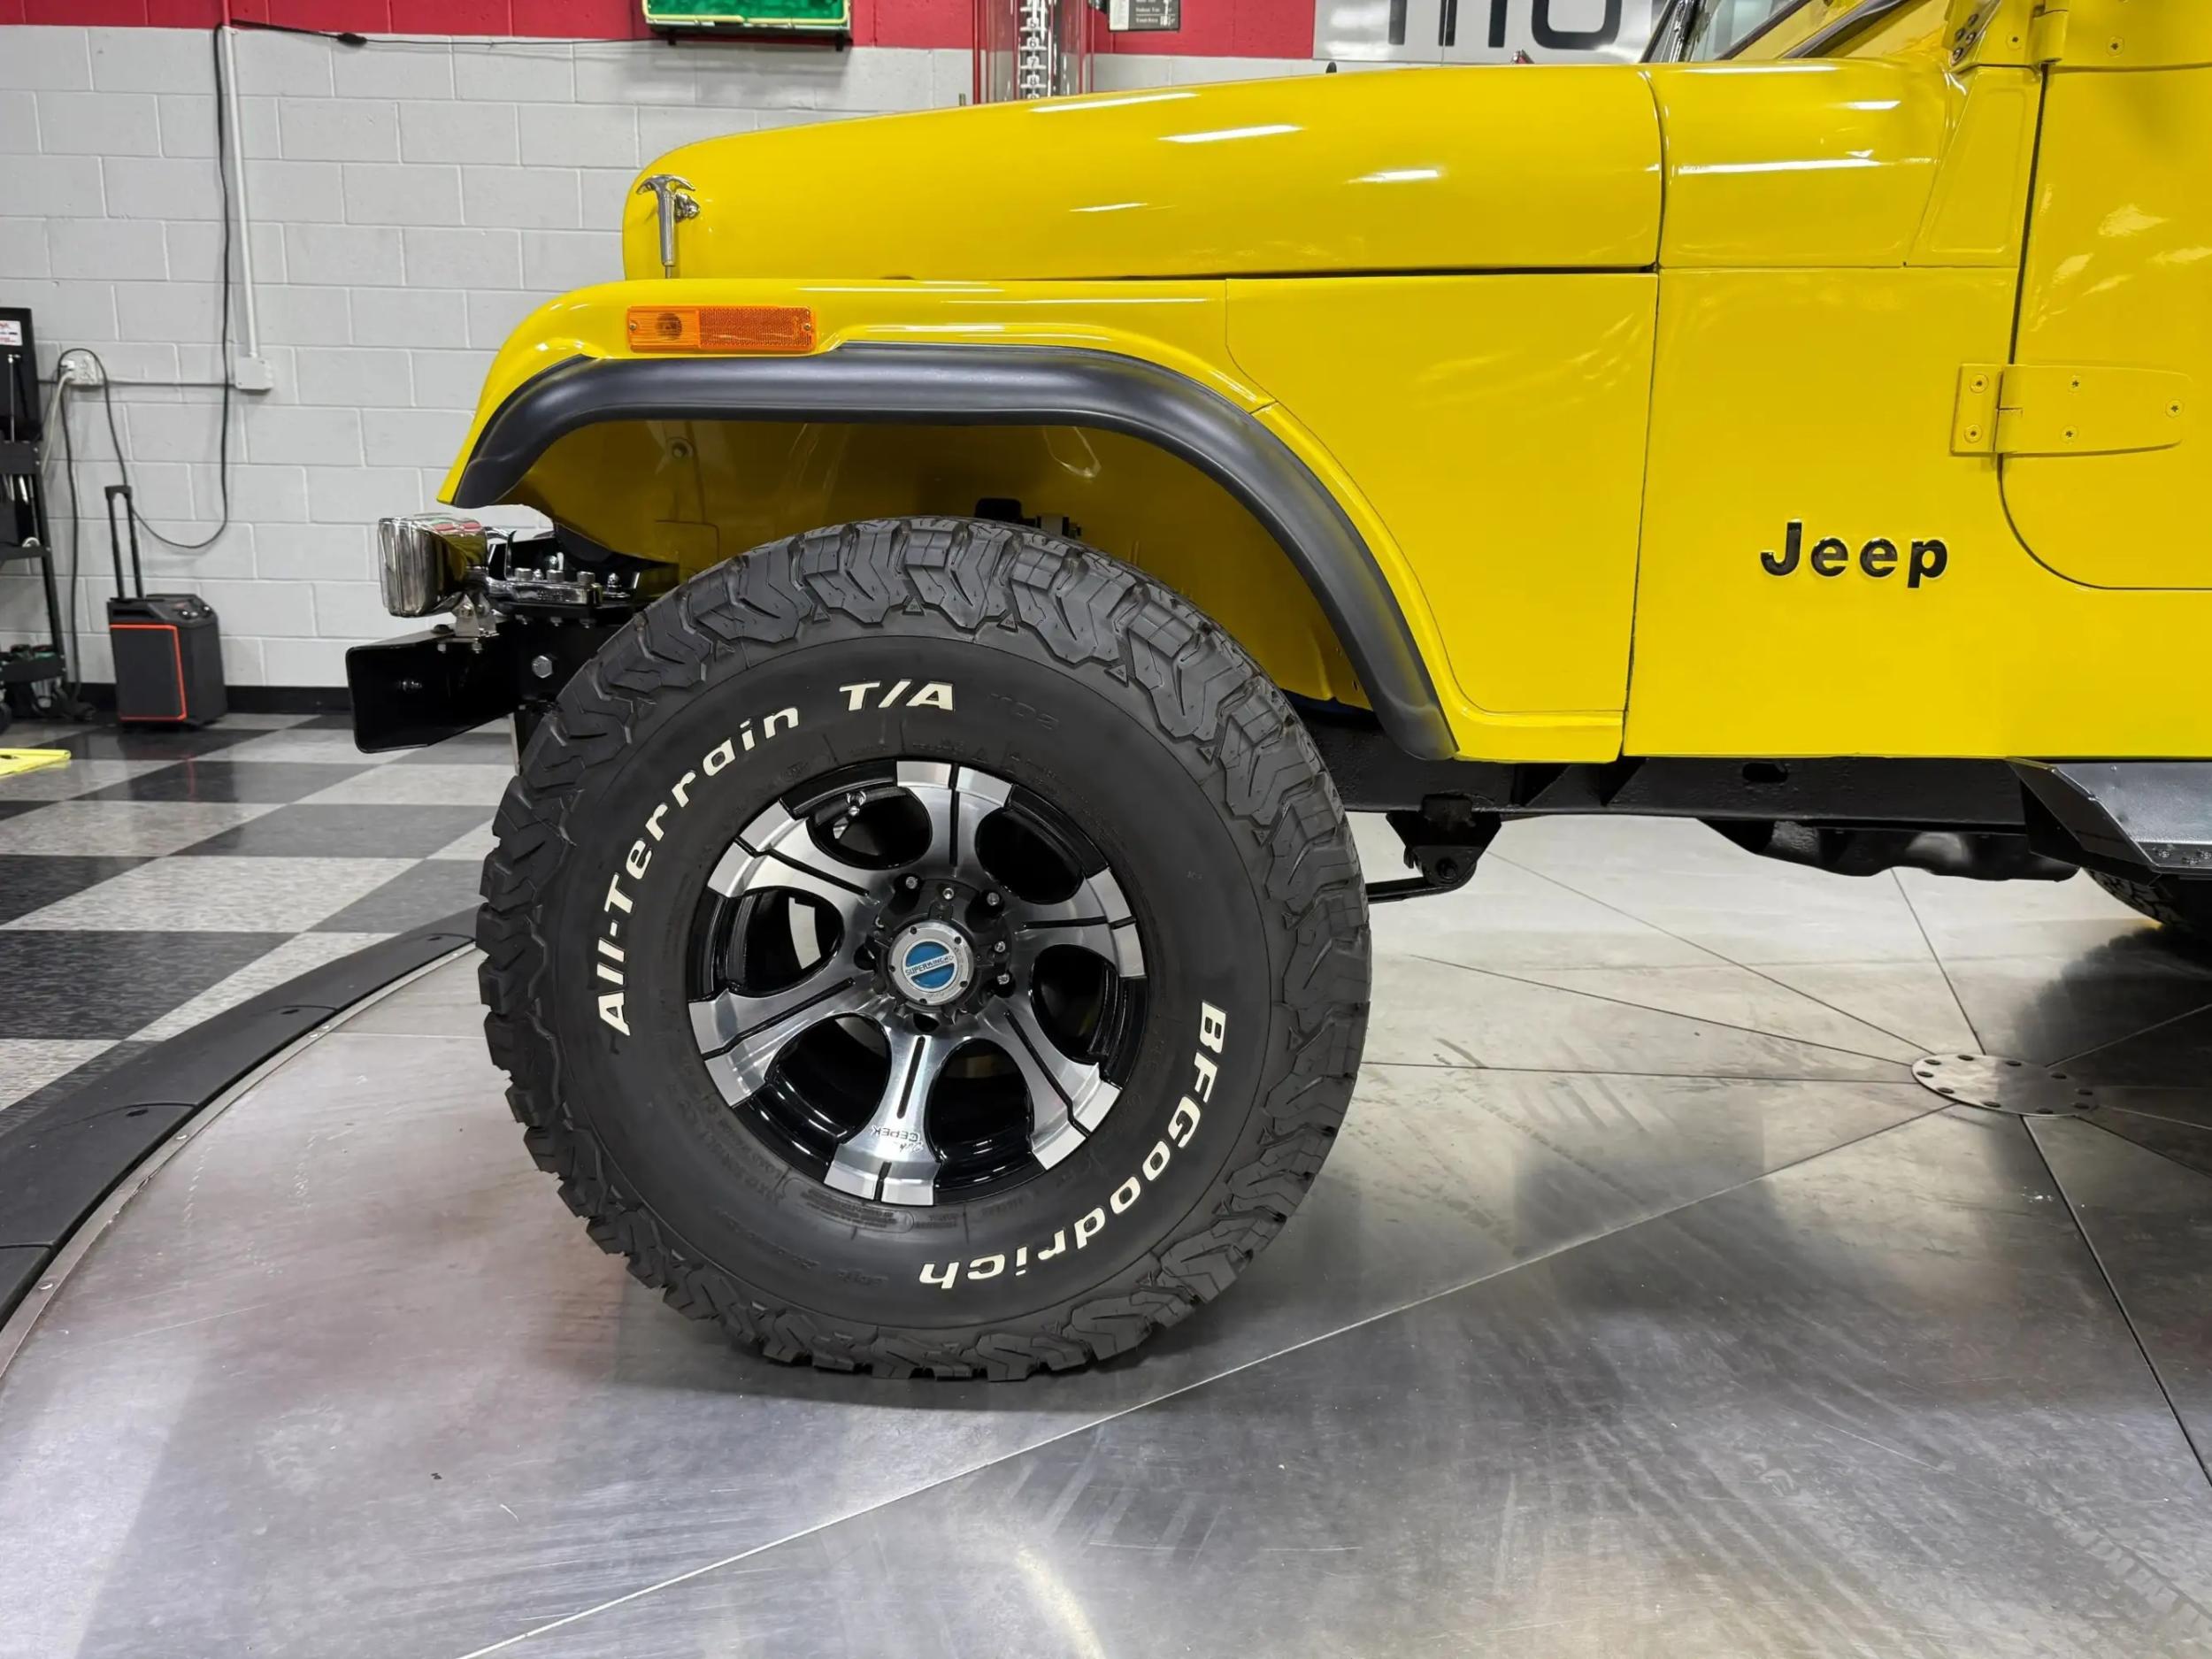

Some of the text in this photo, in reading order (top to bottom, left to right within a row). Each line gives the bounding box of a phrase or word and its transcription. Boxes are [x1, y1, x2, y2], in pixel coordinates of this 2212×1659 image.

[1760, 518, 1948, 588] Jeep
[597, 679, 954, 1037] All-Terrain T/A
[871, 1125, 921, 1143] CEPEK
[918, 1001, 1226, 1289] BFGoodrich
